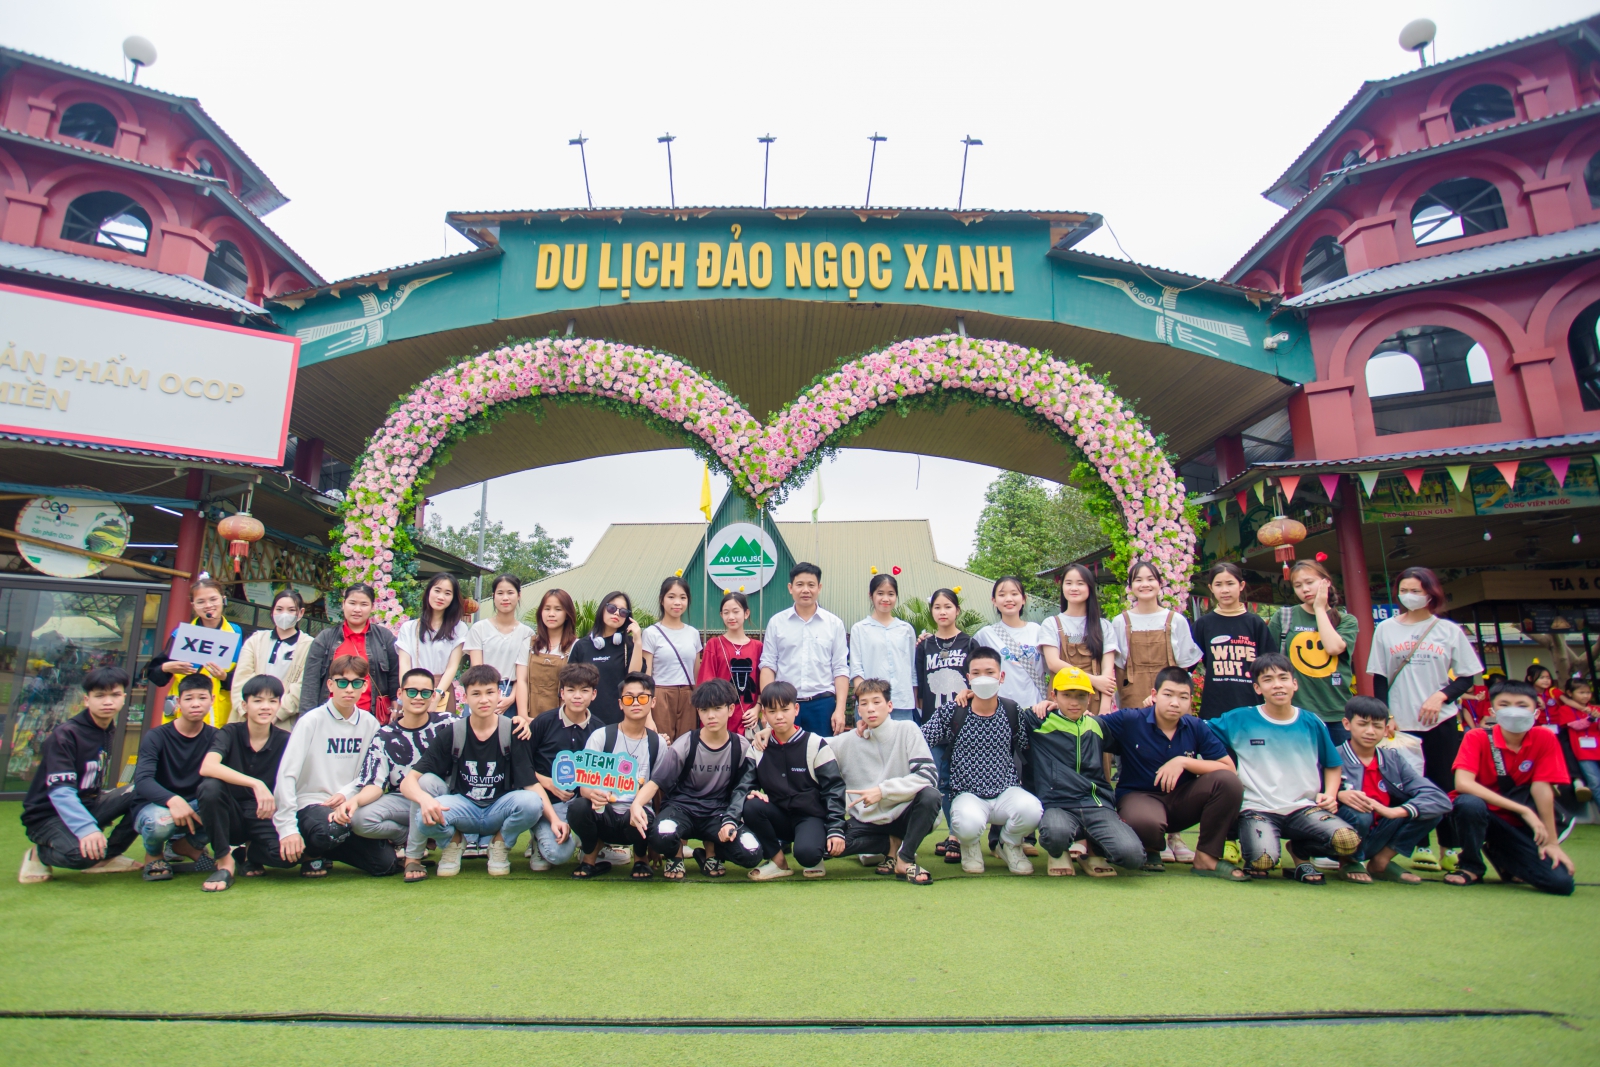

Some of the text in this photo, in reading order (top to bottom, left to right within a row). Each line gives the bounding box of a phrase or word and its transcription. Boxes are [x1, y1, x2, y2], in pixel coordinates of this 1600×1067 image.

[535, 223, 1015, 299] DU LỊCH ĐẢO NGỌC XANH
[54, 353, 149, 390] PHẨM
[159, 372, 245, 403] OCOP
[1549, 578, 1575, 591] TEA
[1579, 577, 1589, 590] &
[181, 636, 229, 657] XE 7
[1210, 645, 1256, 662] WIPE
[926, 653, 965, 671] MATCH
[327, 737, 362, 754] NICE
[576, 768, 635, 792] Thích du lịch
